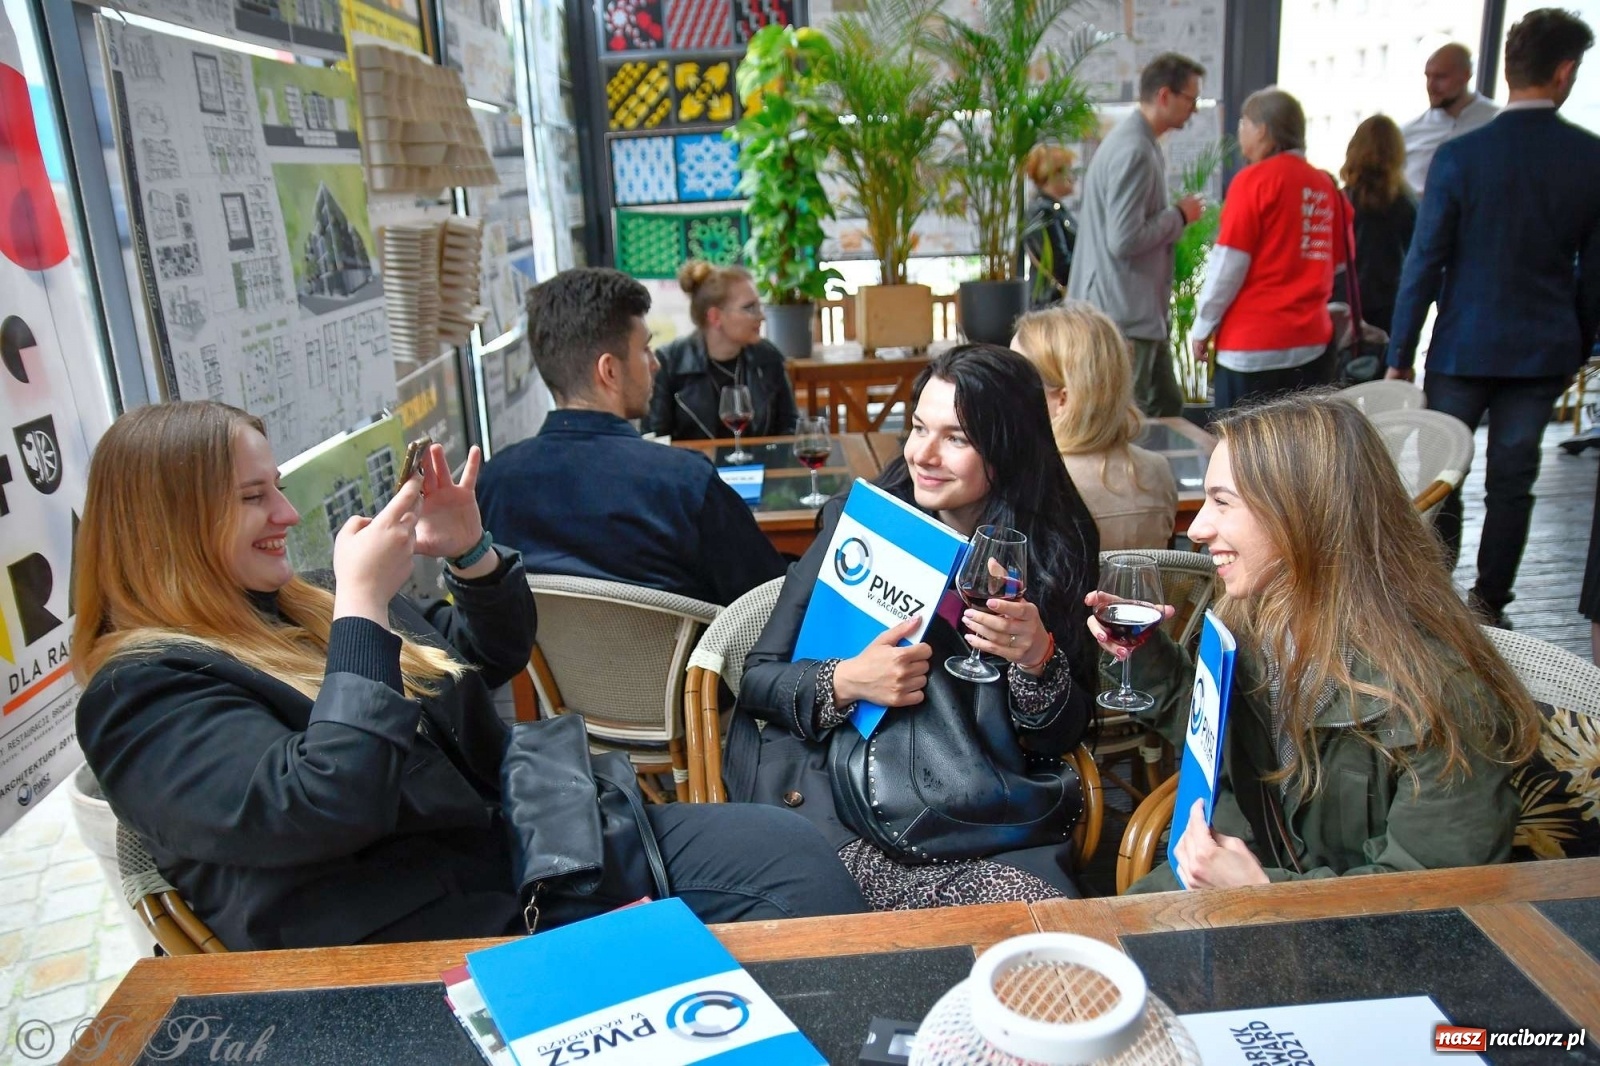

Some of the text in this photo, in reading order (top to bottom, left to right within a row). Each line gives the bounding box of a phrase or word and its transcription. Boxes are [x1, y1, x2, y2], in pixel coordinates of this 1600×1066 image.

[869, 574, 925, 617] PWSZ
[876, 598, 909, 621] RACIBOR
[9, 659, 42, 695] DLA
[7, 715, 49, 751] RESTAURACJI
[0, 749, 56, 797] ARCHITEKTURY
[59, 733, 77, 750] 2011-
[537, 1019, 622, 1053] RACIBORZU
[540, 1017, 657, 1066] PWSZ
[1249, 1021, 1293, 1066] WARD
